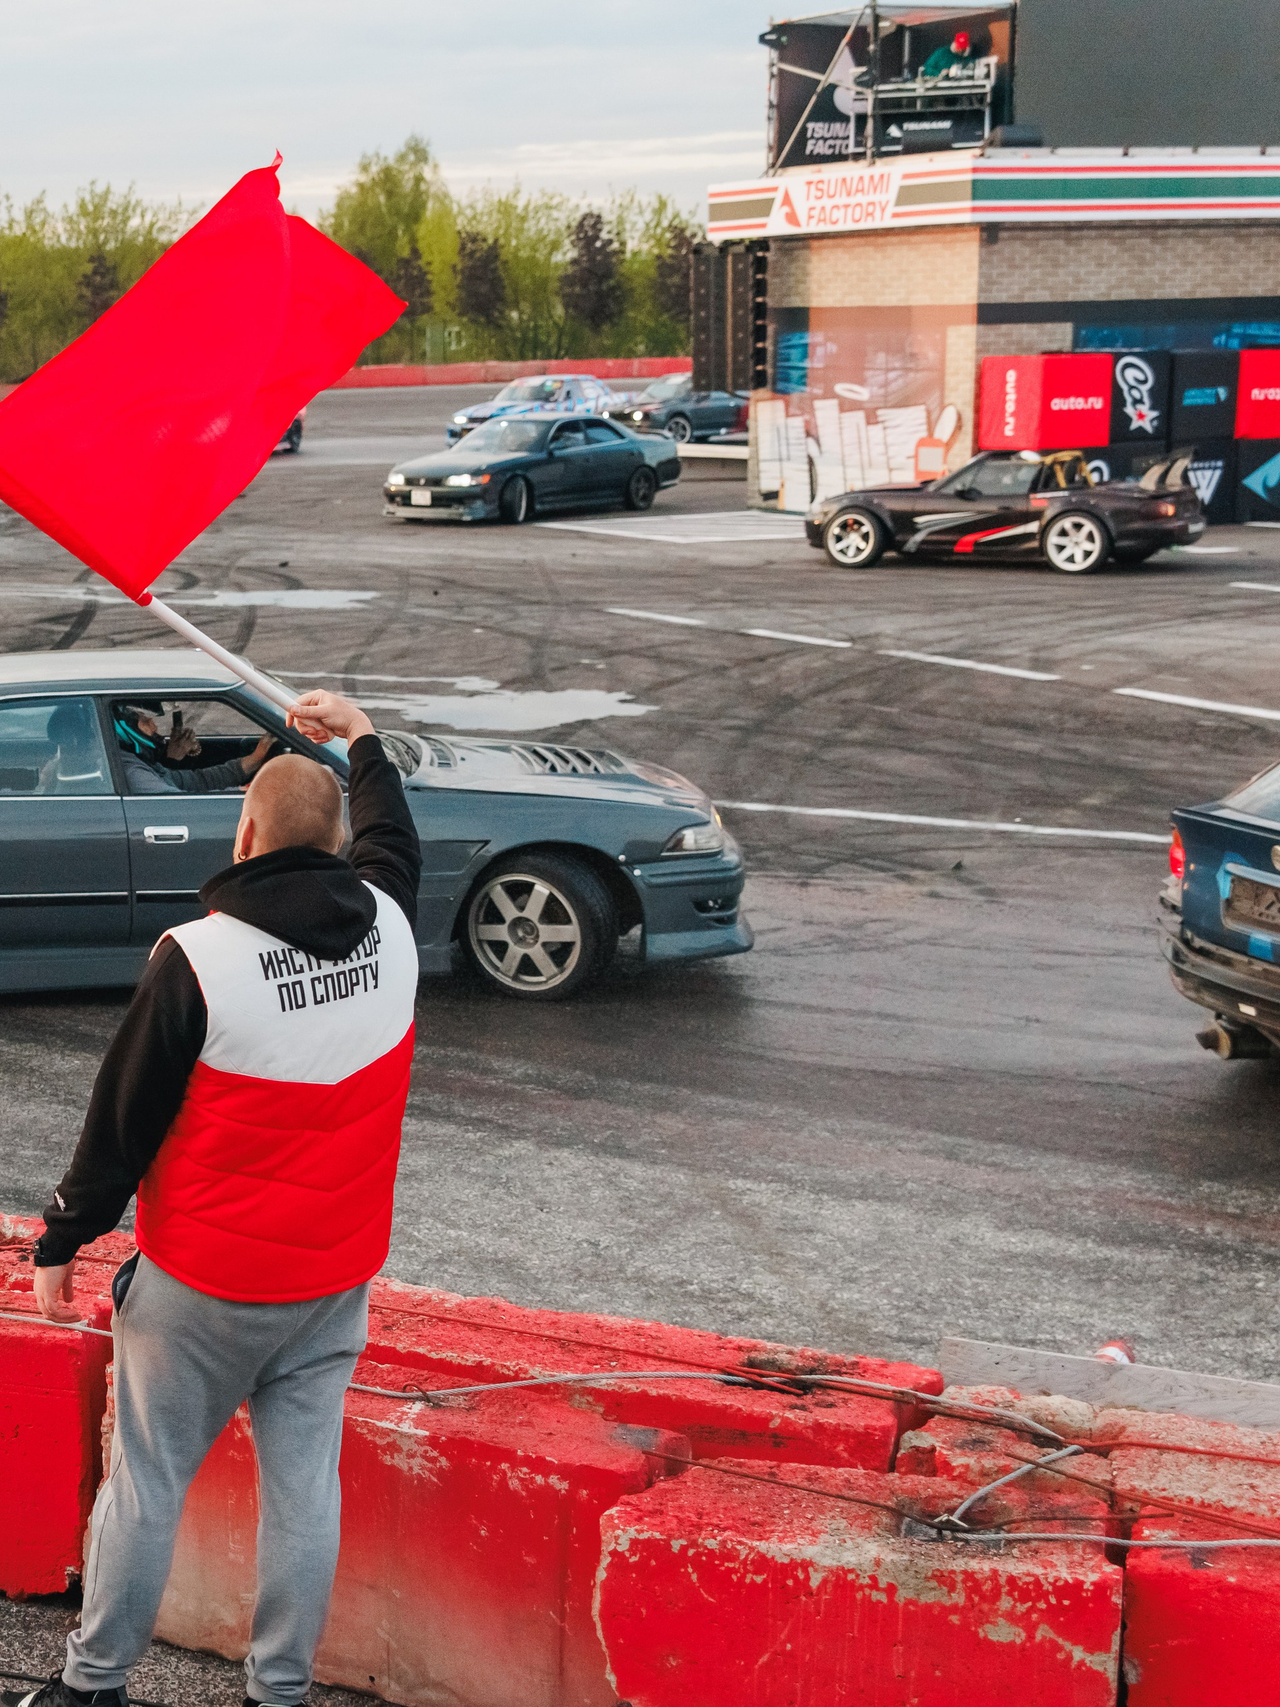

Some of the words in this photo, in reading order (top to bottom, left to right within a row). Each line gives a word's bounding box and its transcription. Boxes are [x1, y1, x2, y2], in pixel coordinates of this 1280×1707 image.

[805, 173, 891, 201] TSUNAMI
[806, 200, 889, 227] FACTORY
[1004, 369, 1016, 437] auto.ru
[1050, 396, 1104, 411] auto.ru
[277, 979, 307, 1012] ПО
[310, 960, 379, 1006] СПОРТУ
